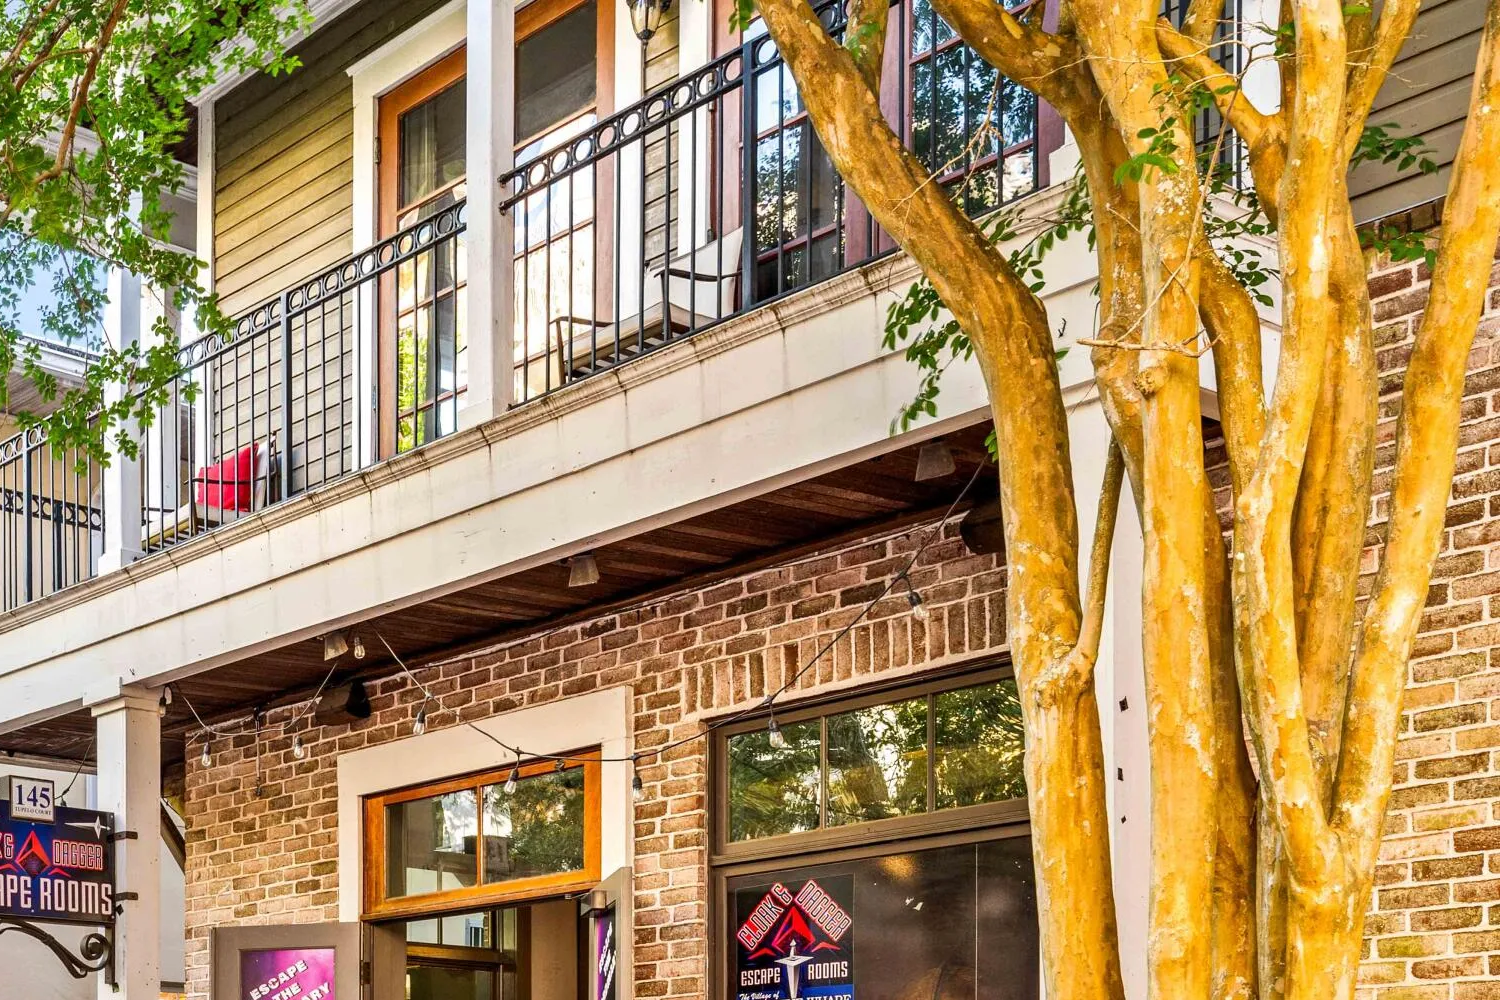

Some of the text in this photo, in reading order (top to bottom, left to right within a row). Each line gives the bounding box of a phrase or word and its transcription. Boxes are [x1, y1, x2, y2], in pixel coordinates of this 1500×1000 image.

[15, 784, 50, 808] 145
[3, 833, 13, 860] &
[52, 839, 103, 870] DAGGER
[40, 877, 113, 916] ROOMS
[794, 879, 852, 942] DAGGER
[736, 882, 793, 950] CLOAK &
[249, 959, 308, 1000] ESCAPE
[741, 961, 848, 986] ESCAPE ROOMS
[739, 990, 780, 1000] The Village of
